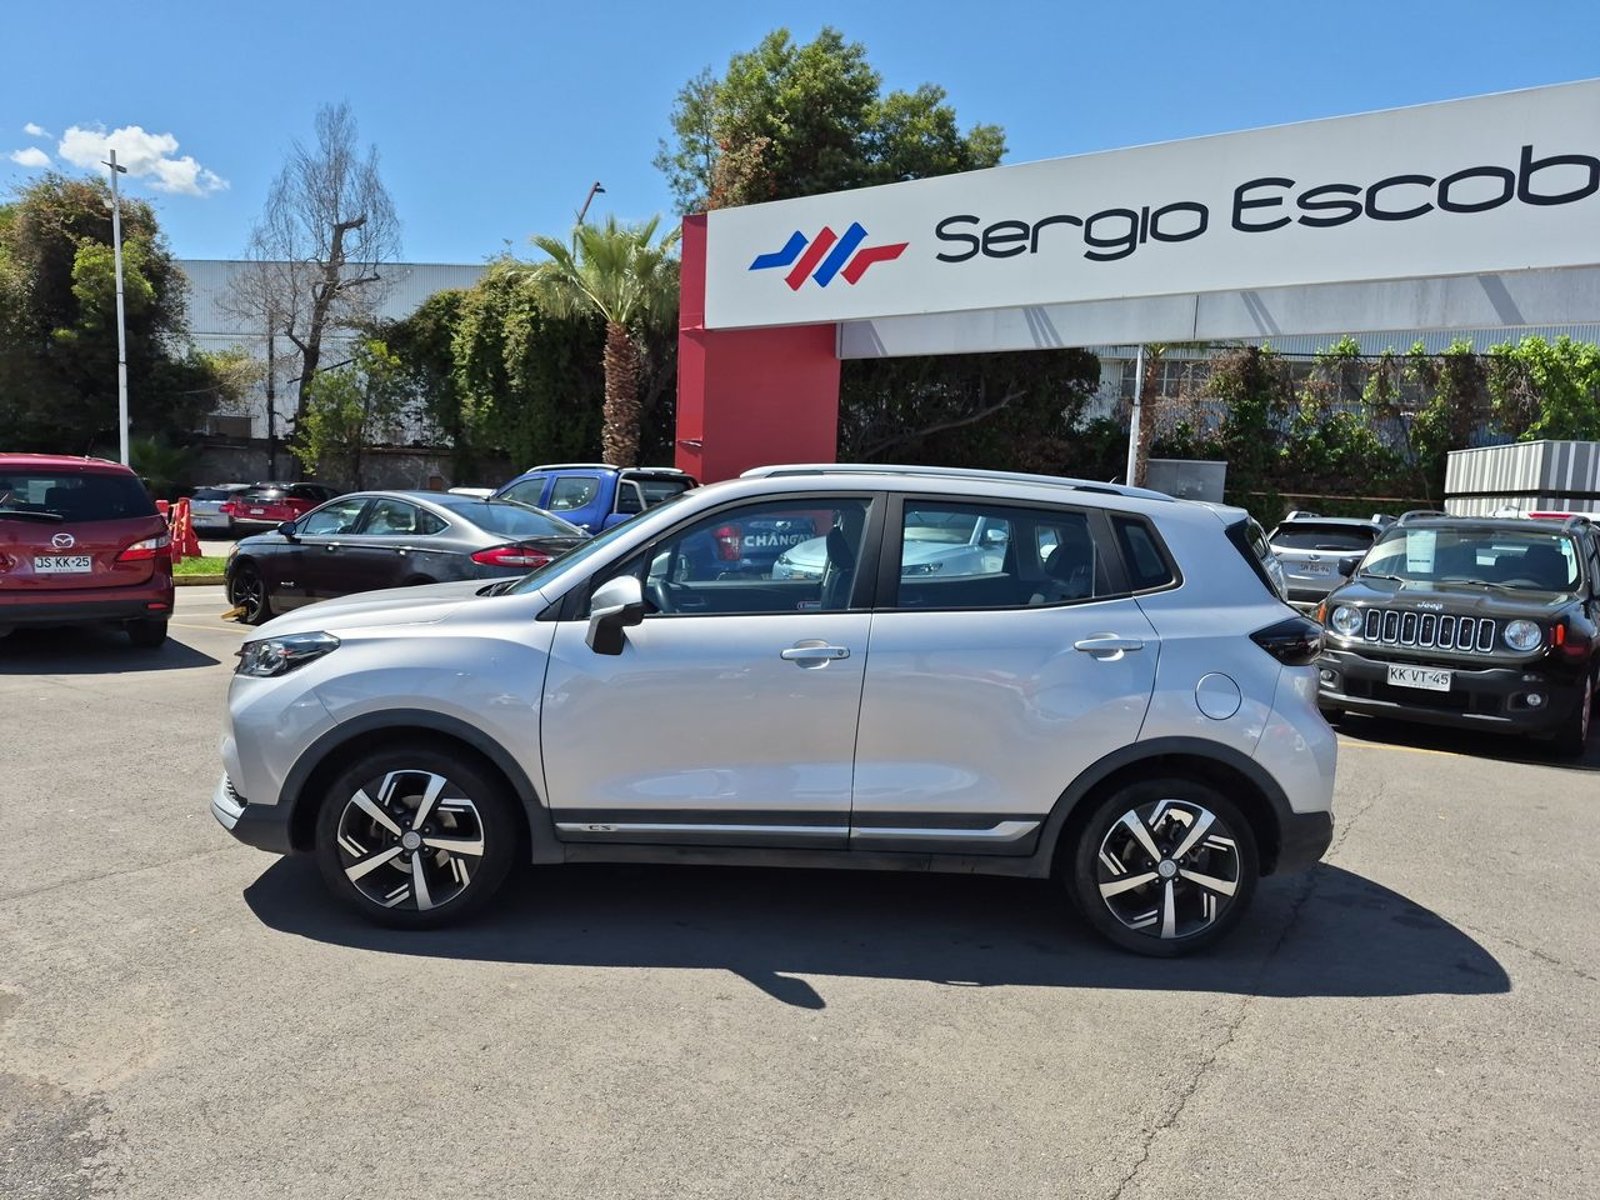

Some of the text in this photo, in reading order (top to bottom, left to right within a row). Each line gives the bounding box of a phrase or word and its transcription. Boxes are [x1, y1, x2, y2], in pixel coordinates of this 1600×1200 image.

[935, 144, 1600, 263] Sergio Escob
[744, 533, 812, 547] CHANGA
[36, 557, 52, 568] JS
[1390, 667, 1406, 680] KK
